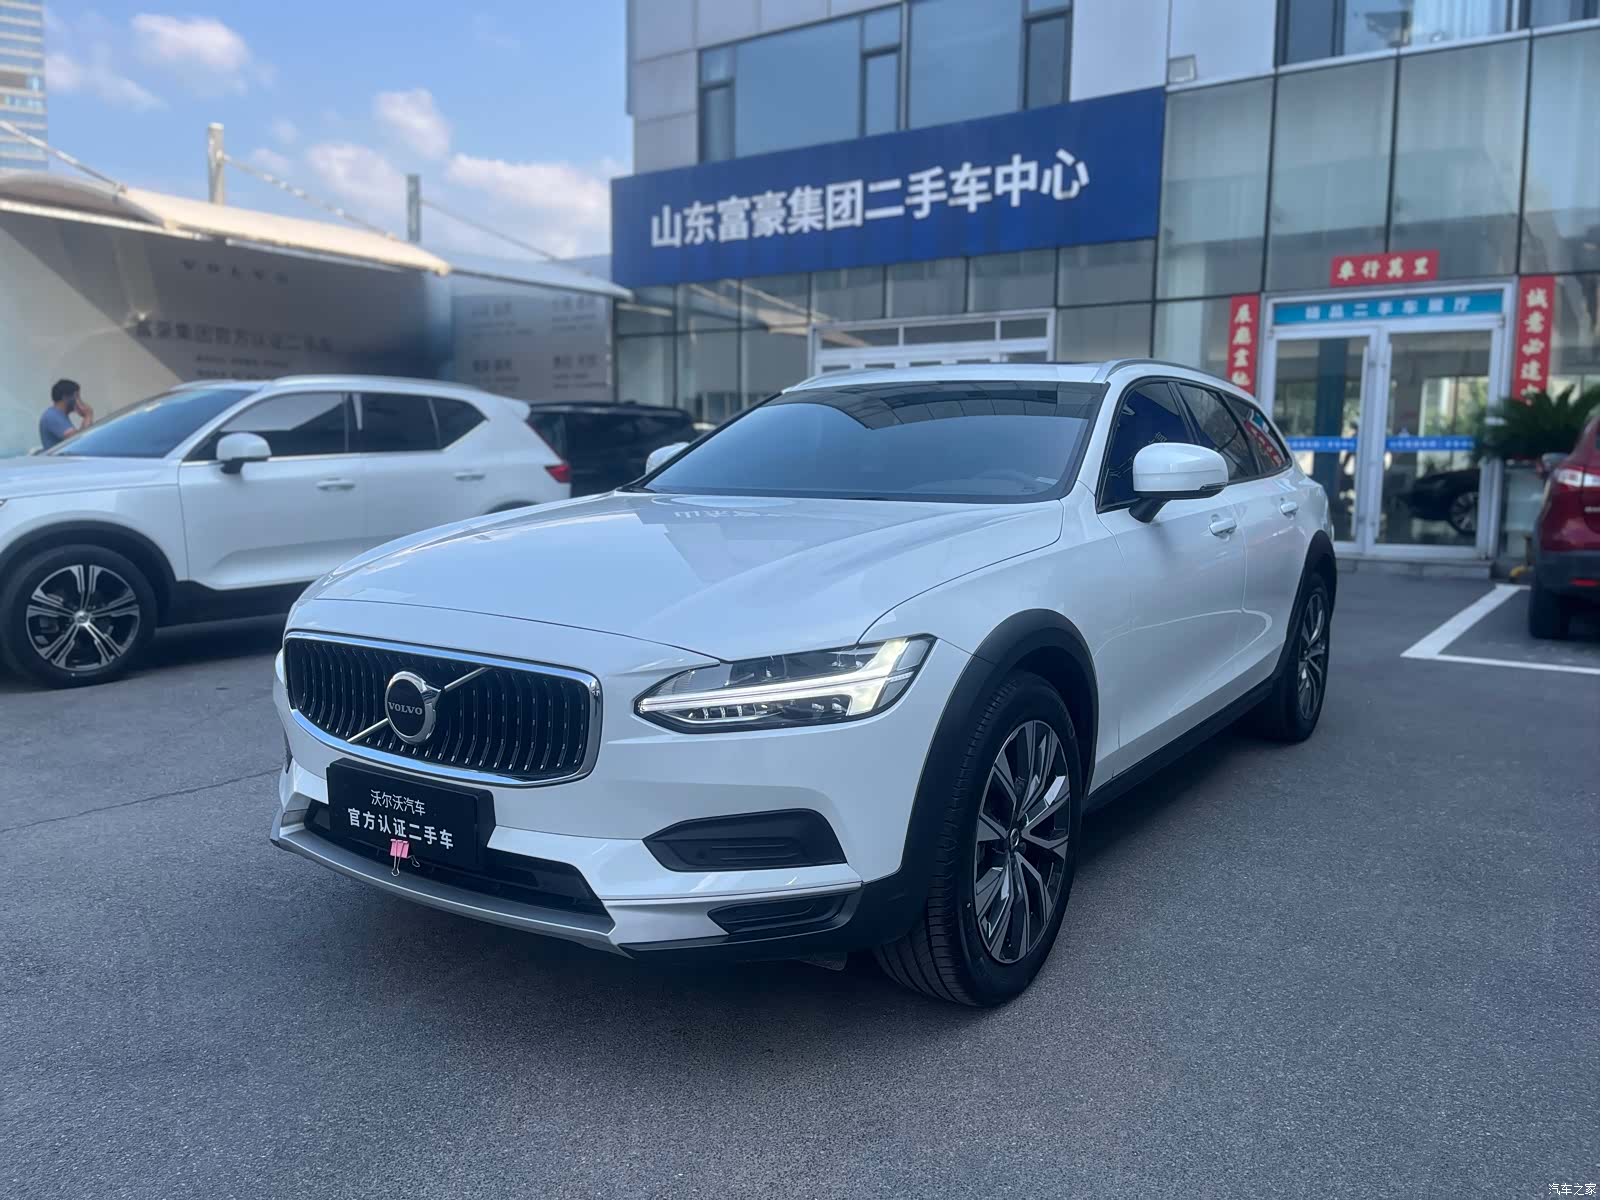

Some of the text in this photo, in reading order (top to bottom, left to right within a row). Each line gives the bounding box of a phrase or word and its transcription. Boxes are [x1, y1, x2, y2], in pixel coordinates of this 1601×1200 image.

[651, 148, 1091, 248] 山东富豪集团二手车中心
[388, 702, 423, 715] VOLVO
[370, 790, 426, 815] 沃尔沃汽车
[347, 807, 455, 850] 官方认证二手车
